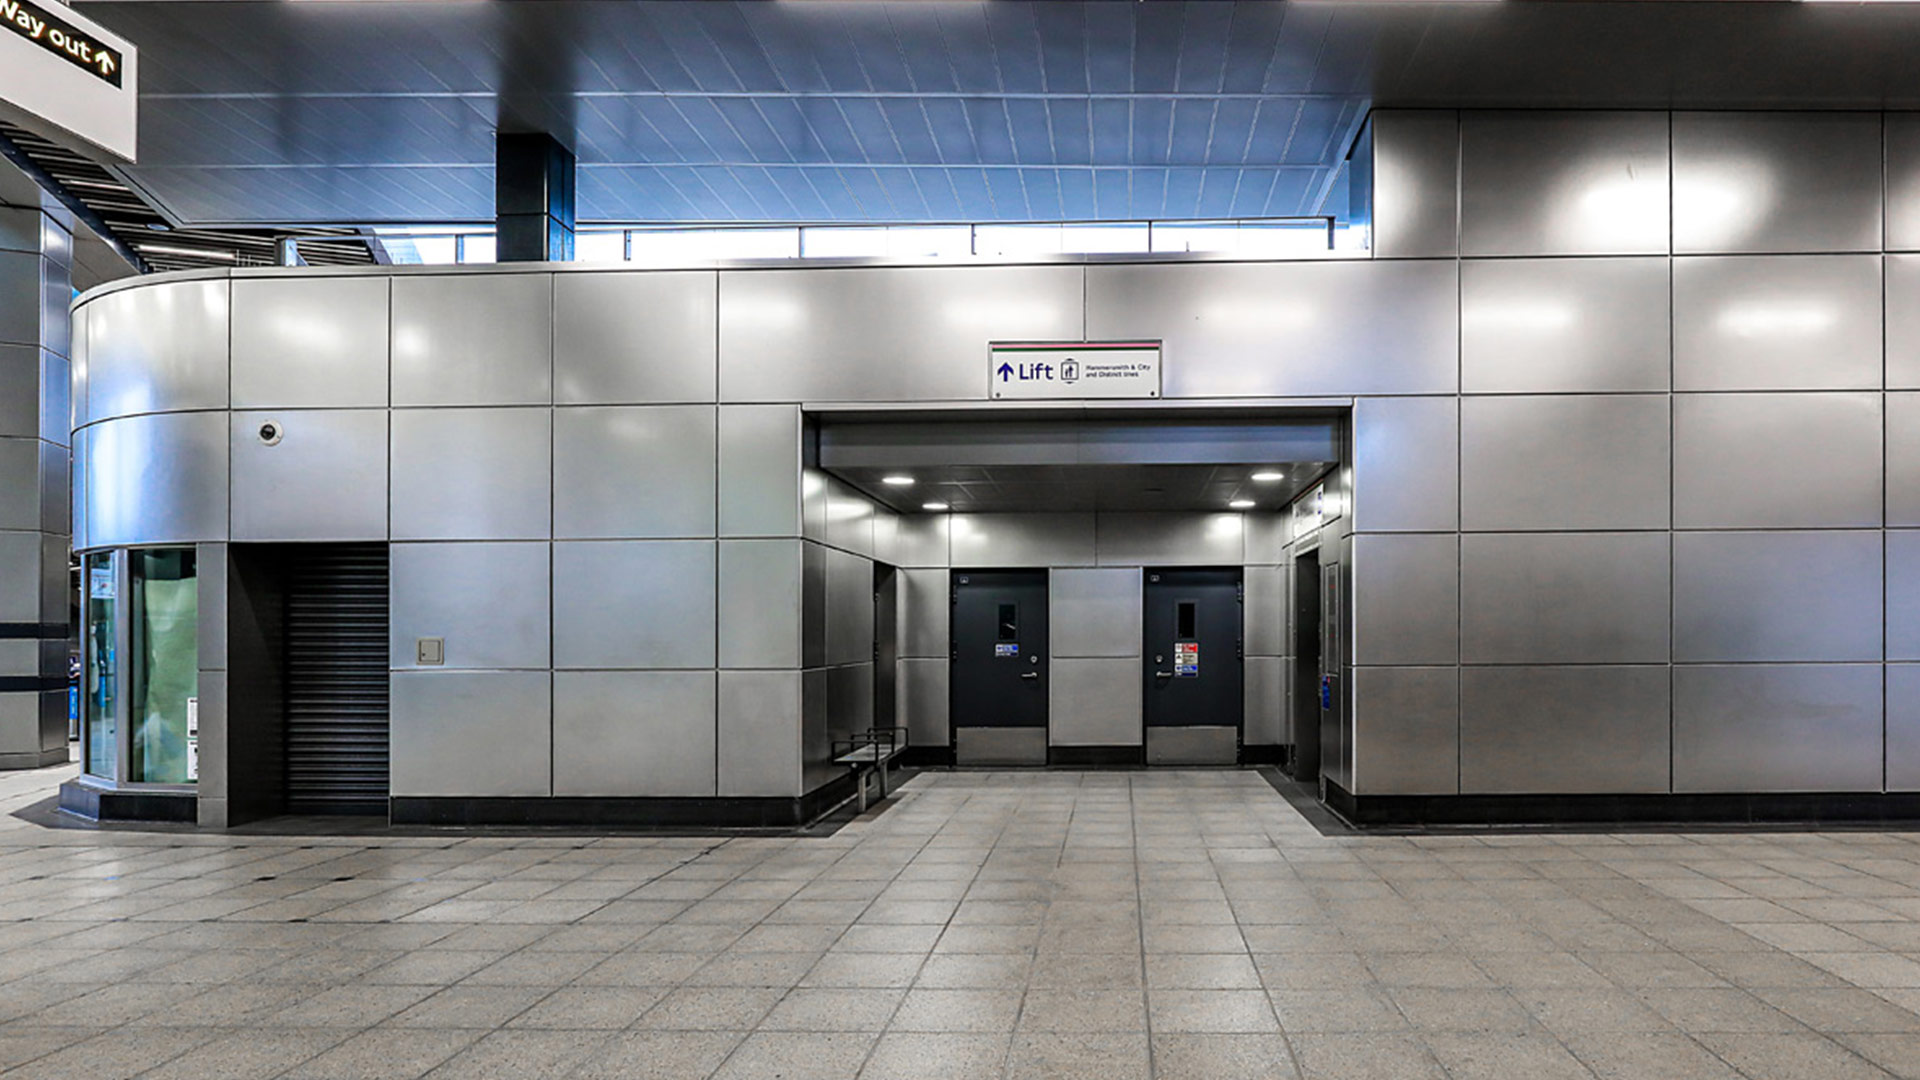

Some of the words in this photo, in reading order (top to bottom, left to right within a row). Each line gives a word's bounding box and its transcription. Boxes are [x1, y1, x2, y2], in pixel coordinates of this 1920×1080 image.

[48, 28, 92, 63] out
[1019, 363, 1054, 380] Lift
[1137, 363, 1151, 372] City
